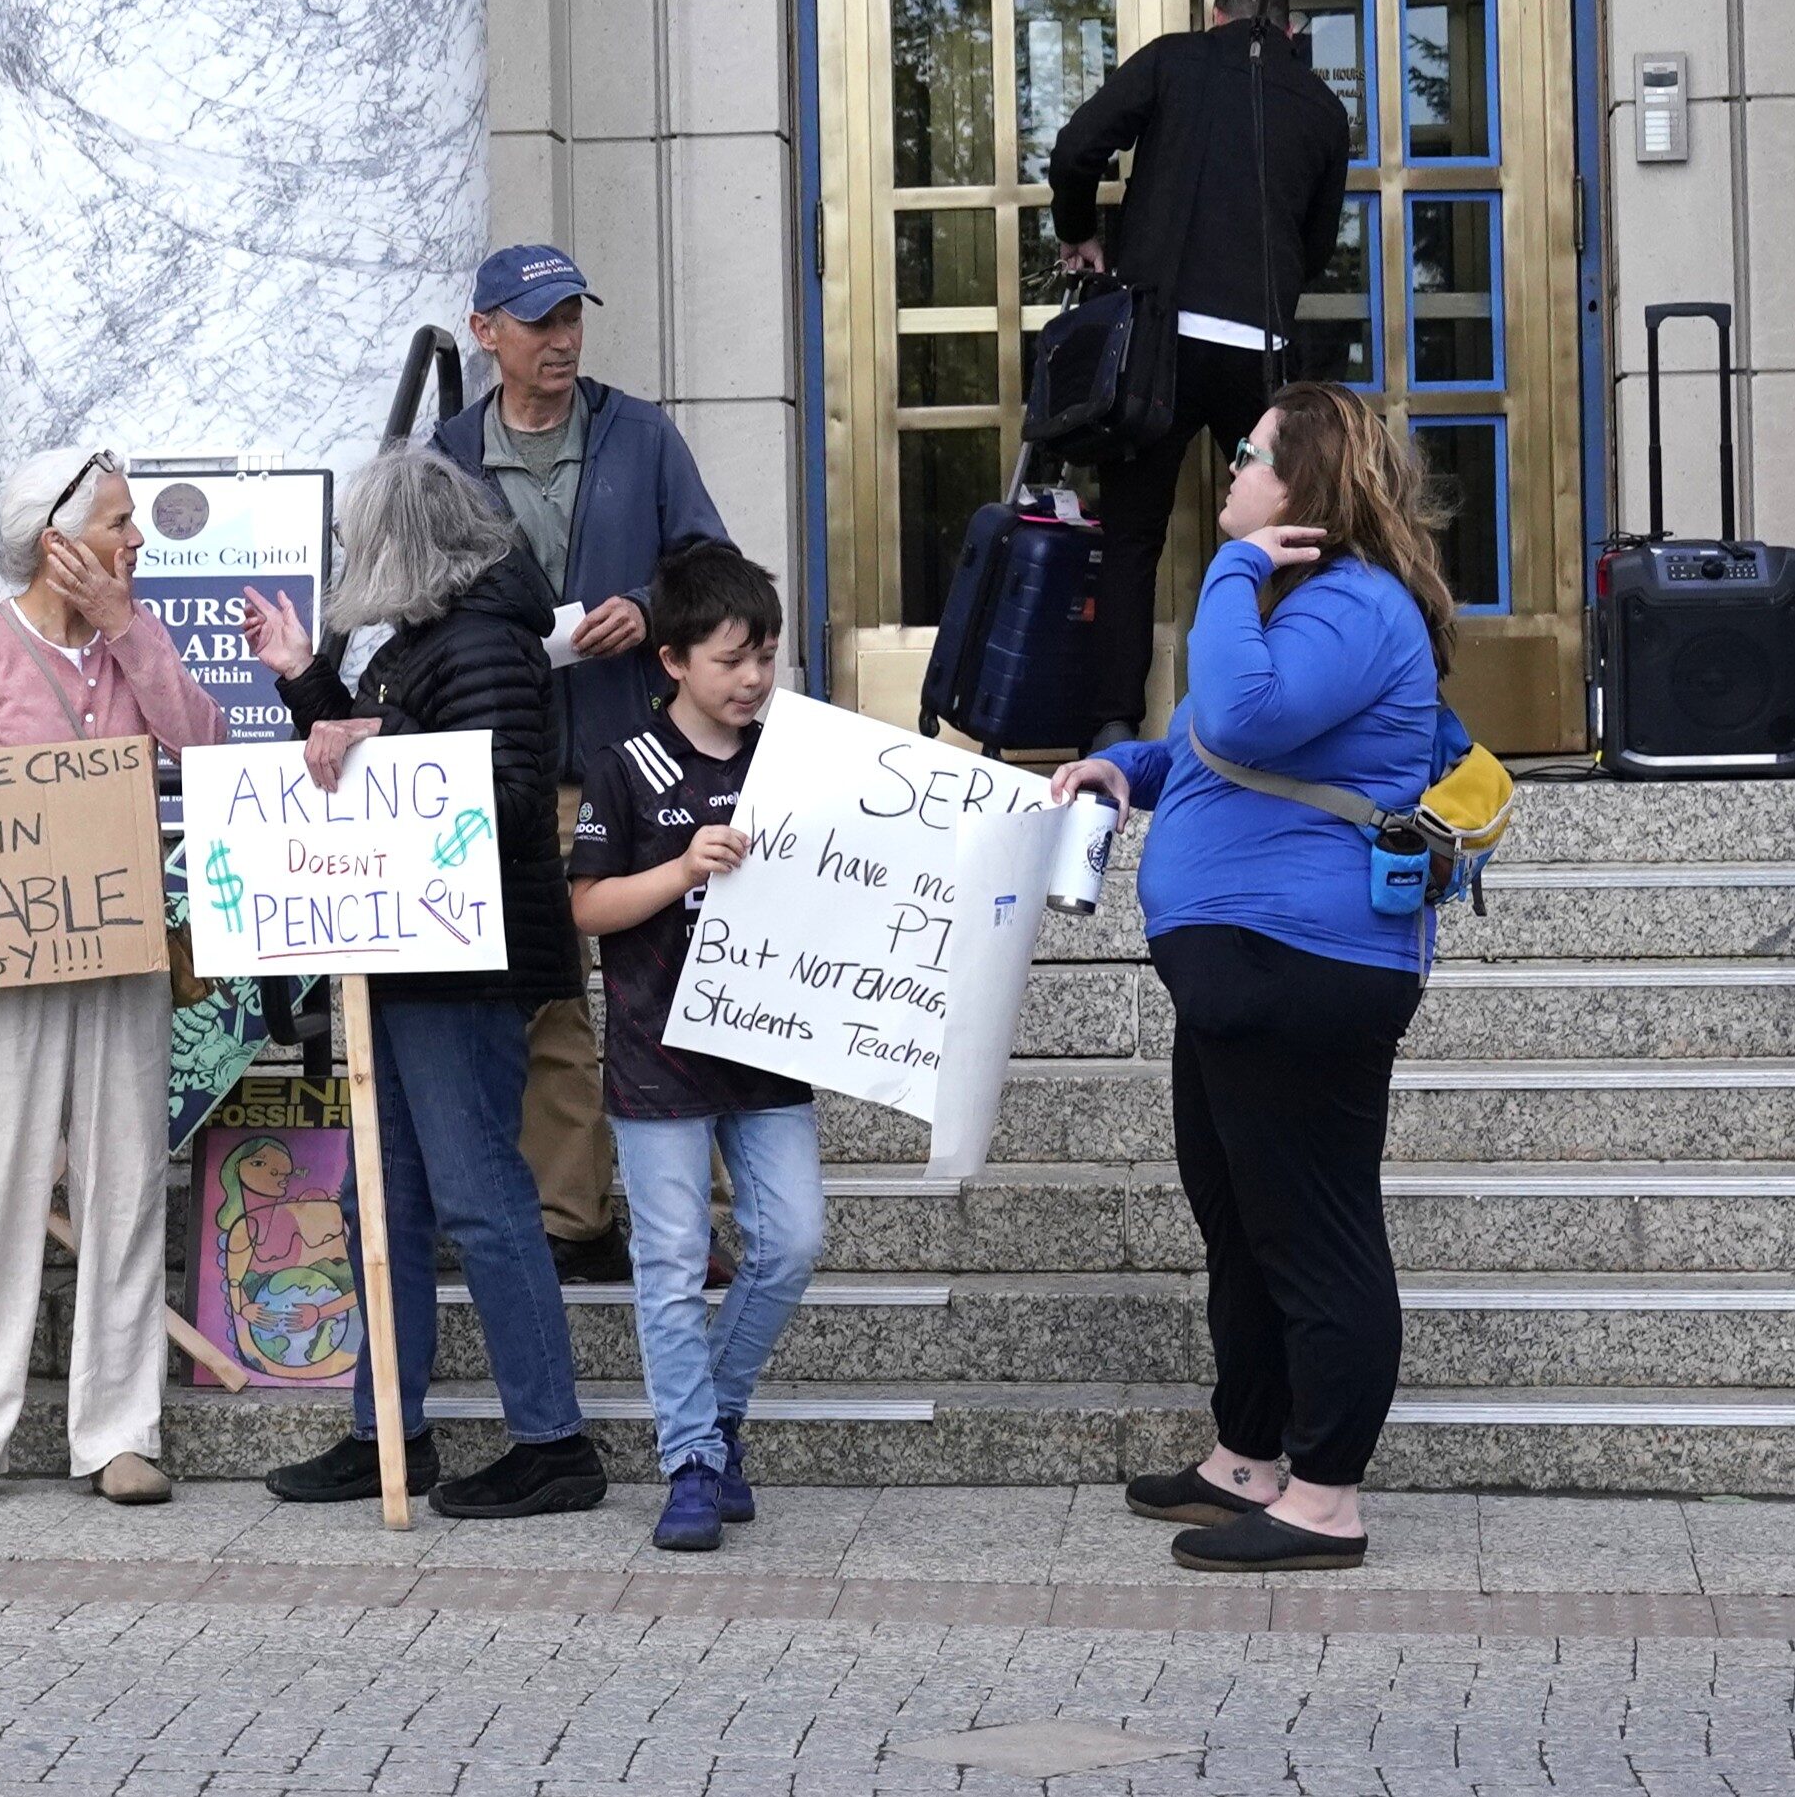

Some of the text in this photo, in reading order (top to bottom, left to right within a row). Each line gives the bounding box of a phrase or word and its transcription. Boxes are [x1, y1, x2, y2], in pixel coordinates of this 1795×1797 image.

[144, 545, 307, 569] State Capitol
[230, 706, 293, 725] SHO
[232, 729, 275, 738] Museum
[25, 744, 140, 787] CRISIS
[749, 805, 797, 861] We
[816, 828, 888, 890] have
[254, 878, 487, 952] PENCIL OUT
[696, 918, 947, 1019] But NOT ENOUG
[683, 979, 814, 1040] Students
